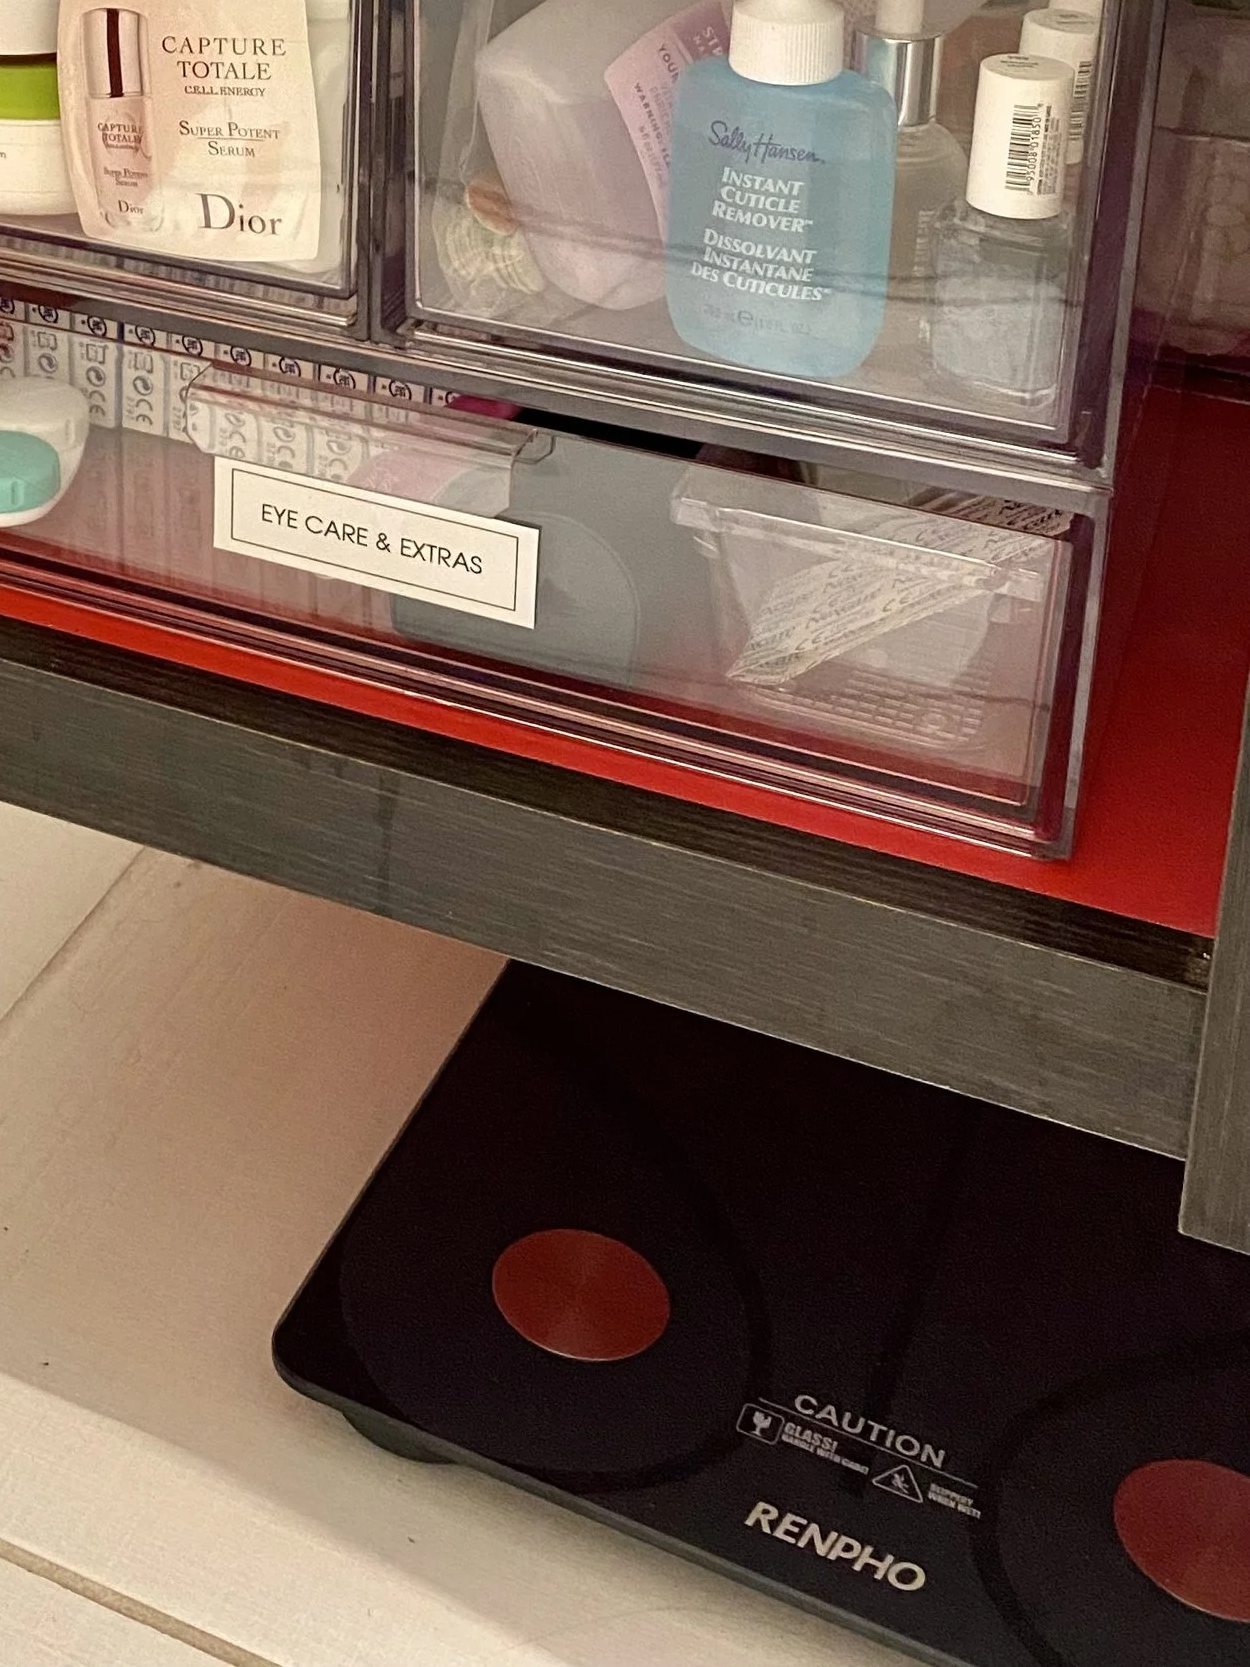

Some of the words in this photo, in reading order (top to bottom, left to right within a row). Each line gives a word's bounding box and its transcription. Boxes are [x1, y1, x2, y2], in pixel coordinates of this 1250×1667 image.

[161, 35, 287, 57] CAPTURE
[176, 60, 273, 81] TOTALE
[97, 122, 143, 134] CAPTURE
[708, 120, 752, 164] Sally
[720, 166, 806, 196] INSTANT
[194, 192, 284, 236] Dior
[719, 185, 801, 214] CUTICLE
[703, 228, 817, 265] DISSOLVANT
[690, 261, 720, 284] DES
[261, 502, 300, 530] EYE
[304, 514, 370, 548] CARE
[376, 531, 393, 554] &
[398, 536, 484, 575] EXTRAS
[794, 1394, 946, 1469] CAUTION
[743, 1500, 927, 1592] RENPHO
